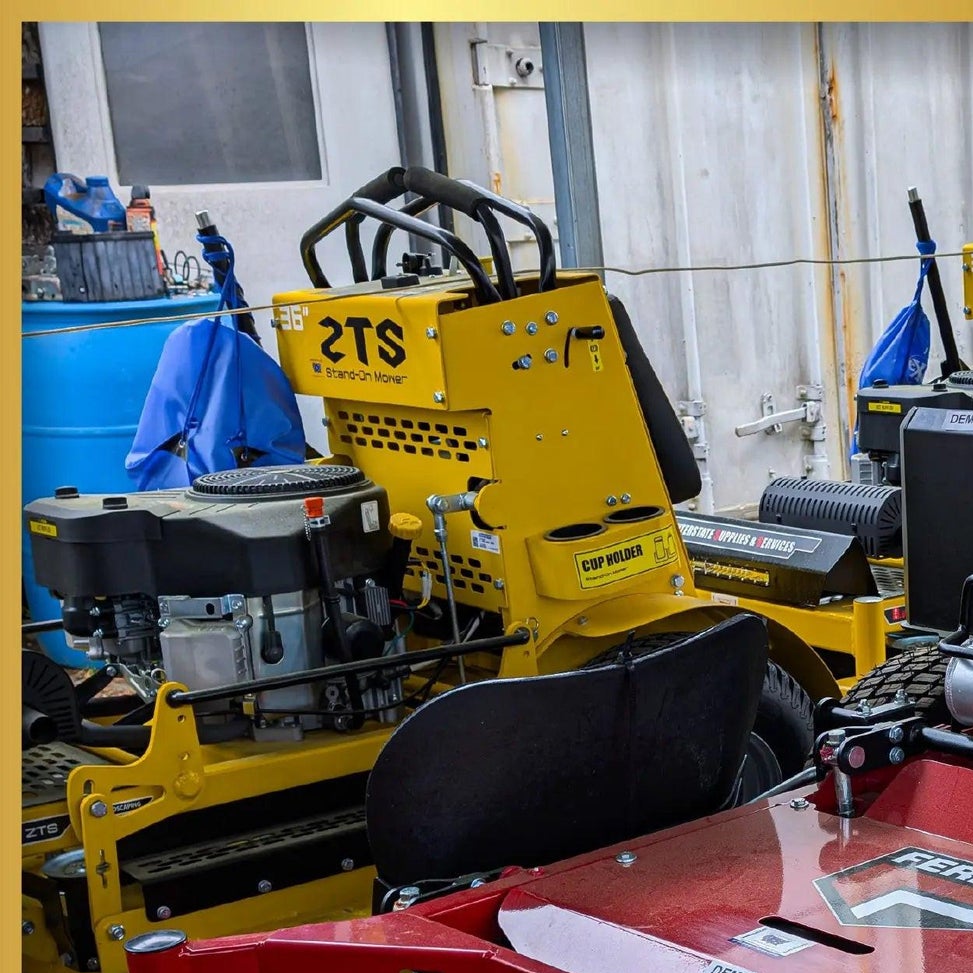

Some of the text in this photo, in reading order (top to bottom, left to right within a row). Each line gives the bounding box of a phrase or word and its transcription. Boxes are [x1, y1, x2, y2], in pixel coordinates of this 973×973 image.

[325, 367, 372, 382] Stand-On
[374, 371, 408, 385] Mower
[712, 528, 751, 545] SUPPLIES
[749, 537, 756, 547] &
[755, 536, 796, 553] SERVICES
[581, 544, 644, 573] CUP HOLDER
[25, 823, 59, 839] ZTS
